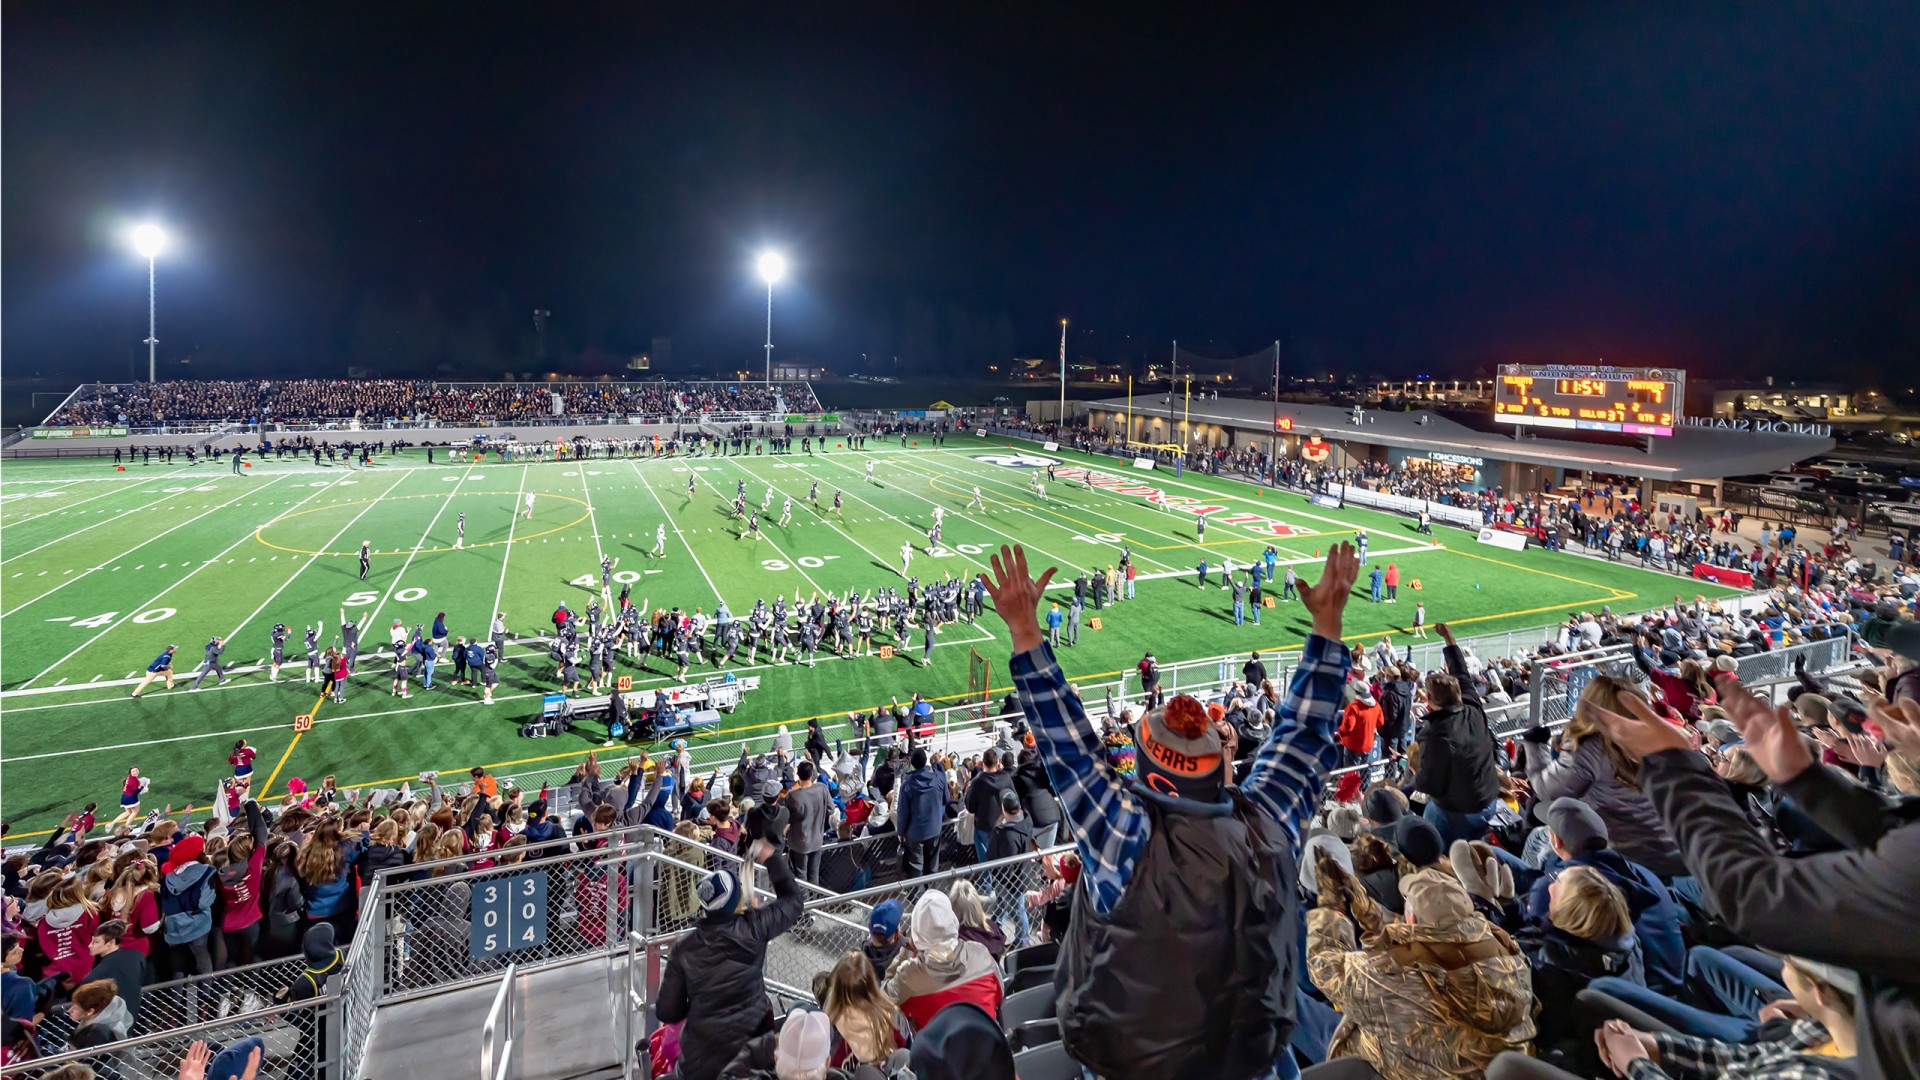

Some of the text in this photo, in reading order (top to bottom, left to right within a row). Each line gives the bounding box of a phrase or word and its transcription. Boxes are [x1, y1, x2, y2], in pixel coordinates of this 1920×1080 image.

[1530, 370, 1634, 381] UNION STADIUM
[1546, 364, 1615, 373] WELCOME TO
[1561, 380, 1605, 395] 11:54
[1651, 389, 1662, 403] 7
[1497, 402, 1505, 413] 2
[1540, 405, 1549, 417] 5
[1607, 410, 1625, 422] 37
[1661, 413, 1672, 426] 2
[1428, 452, 1484, 466] CONCESSIONS
[761, 556, 825, 571] 30
[341, 587, 428, 607] 50
[69, 607, 177, 629] 40
[881, 647, 892, 658] 30
[619, 678, 631, 690] 40
[296, 716, 310, 730] 50
[1145, 736, 1199, 773] BEARS
[522, 878, 536, 942] 304
[484, 886, 498, 952] 305
